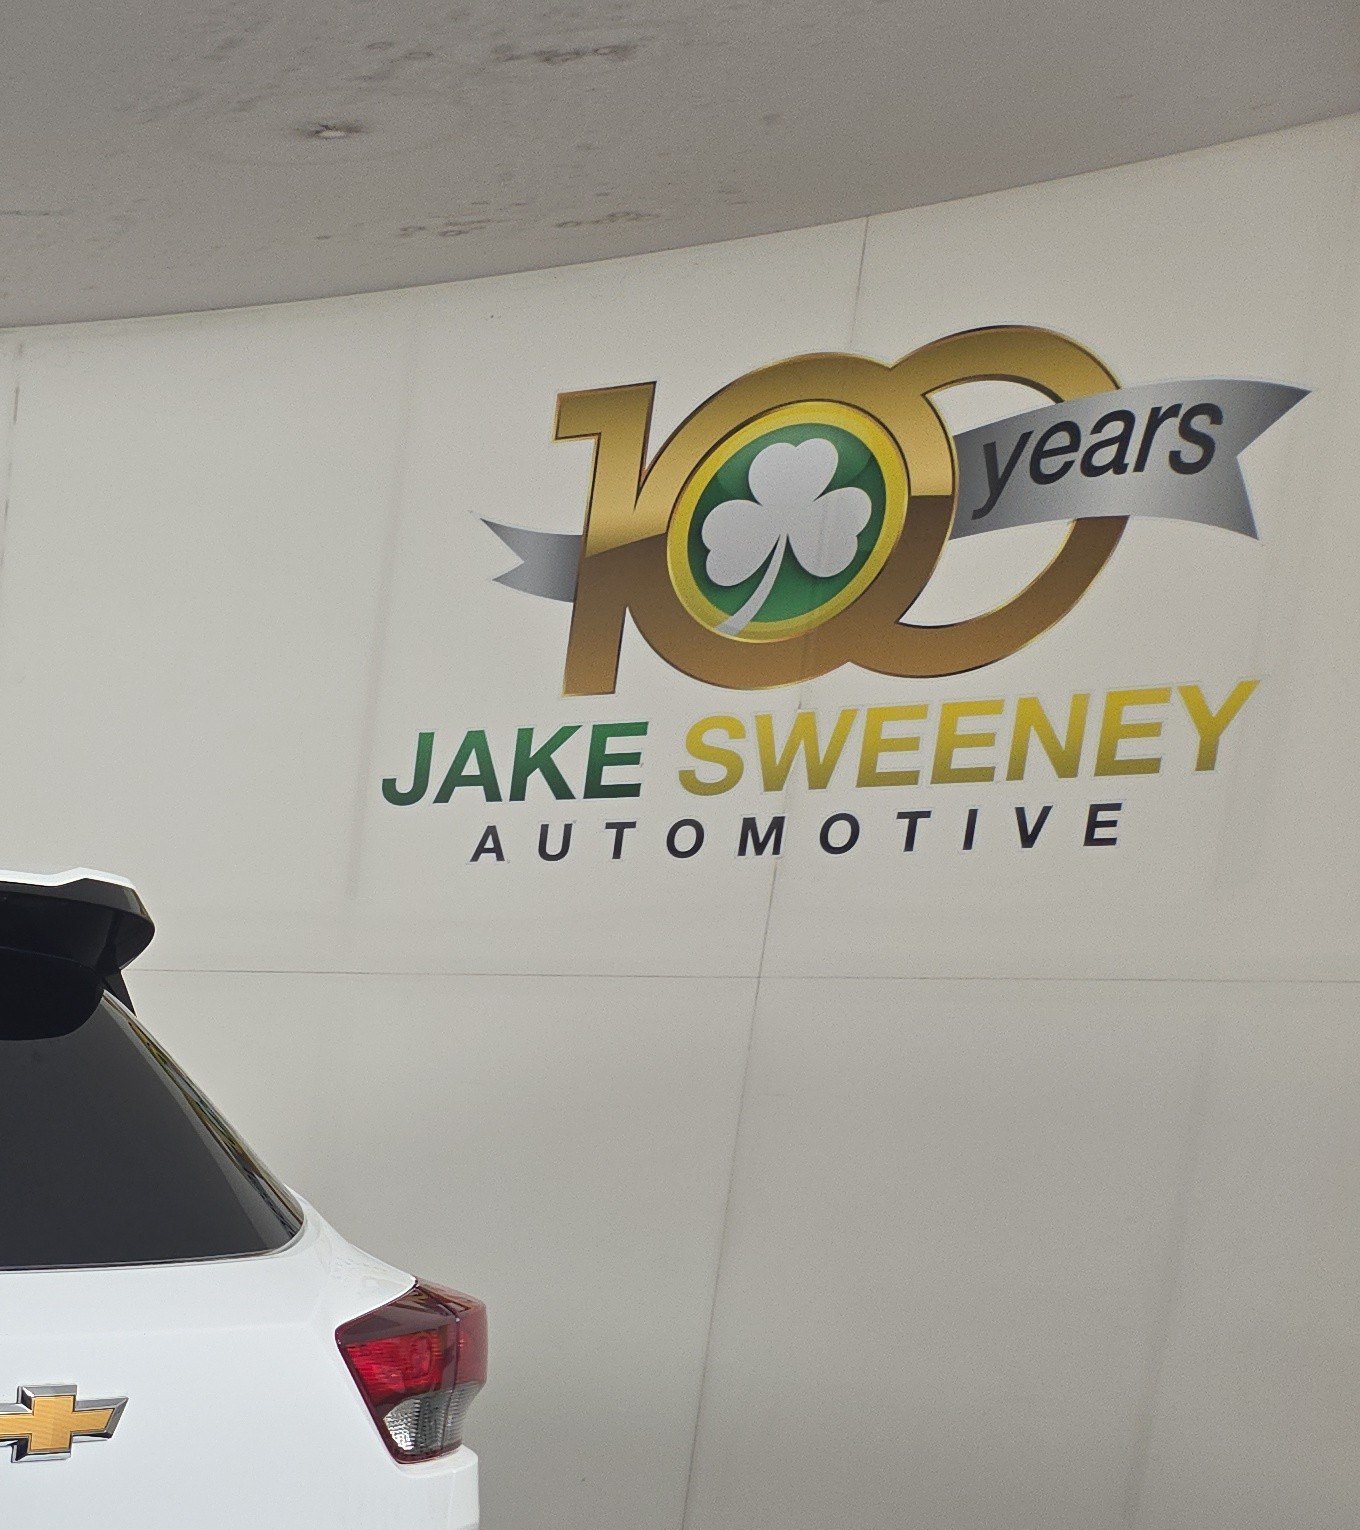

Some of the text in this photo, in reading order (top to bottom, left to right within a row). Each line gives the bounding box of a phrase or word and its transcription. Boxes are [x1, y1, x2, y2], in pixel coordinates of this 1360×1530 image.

[553, 323, 1224, 698] 100 years
[380, 678, 1261, 807] JAKE SWEENEY
[469, 801, 1124, 864] AUTOMOTIVE
